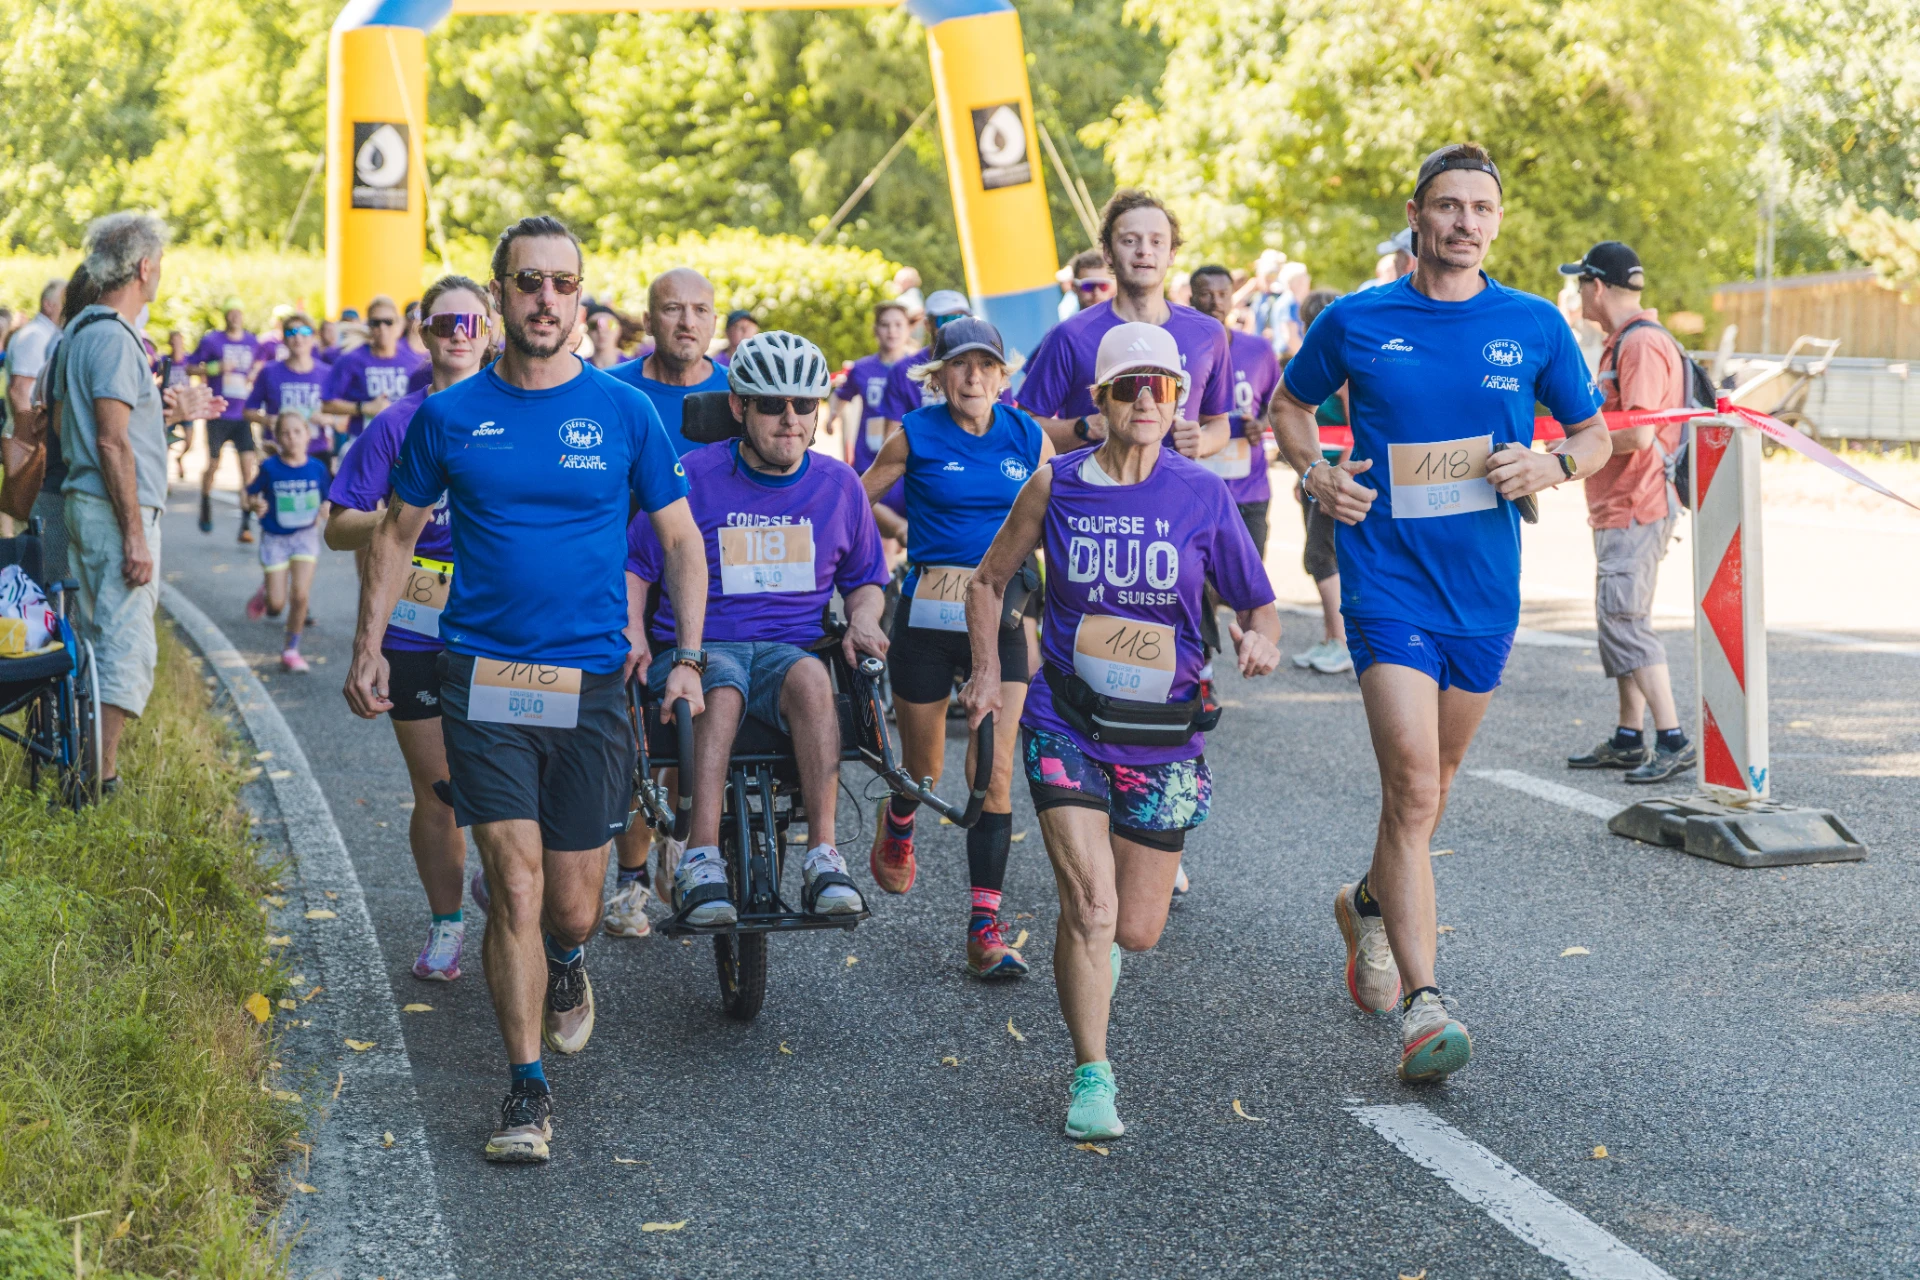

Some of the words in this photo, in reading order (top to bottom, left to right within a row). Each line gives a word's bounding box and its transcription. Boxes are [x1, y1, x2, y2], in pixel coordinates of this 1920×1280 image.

[1486, 382, 1521, 392] ATLANTIC
[1490, 375, 1519, 384] GROUPE
[472, 427, 505, 437] eldera
[563, 460, 607, 470] ATLANTIC
[567, 454, 601, 462] GROUPE
[1415, 449, 1471, 480] 118
[1427, 490, 1460, 506] DUO
[726, 512, 793, 528] COURSE
[1067, 516, 1145, 535] COURSE
[744, 531, 786, 562] 118
[1067, 536, 1179, 590] DUO
[406, 571, 434, 603] 18
[1117, 591, 1178, 606] SUISSE
[1105, 626, 1161, 661] 118
[497, 662, 560, 685] 118
[1106, 670, 1141, 688] DUO
[509, 697, 544, 714] DUO
